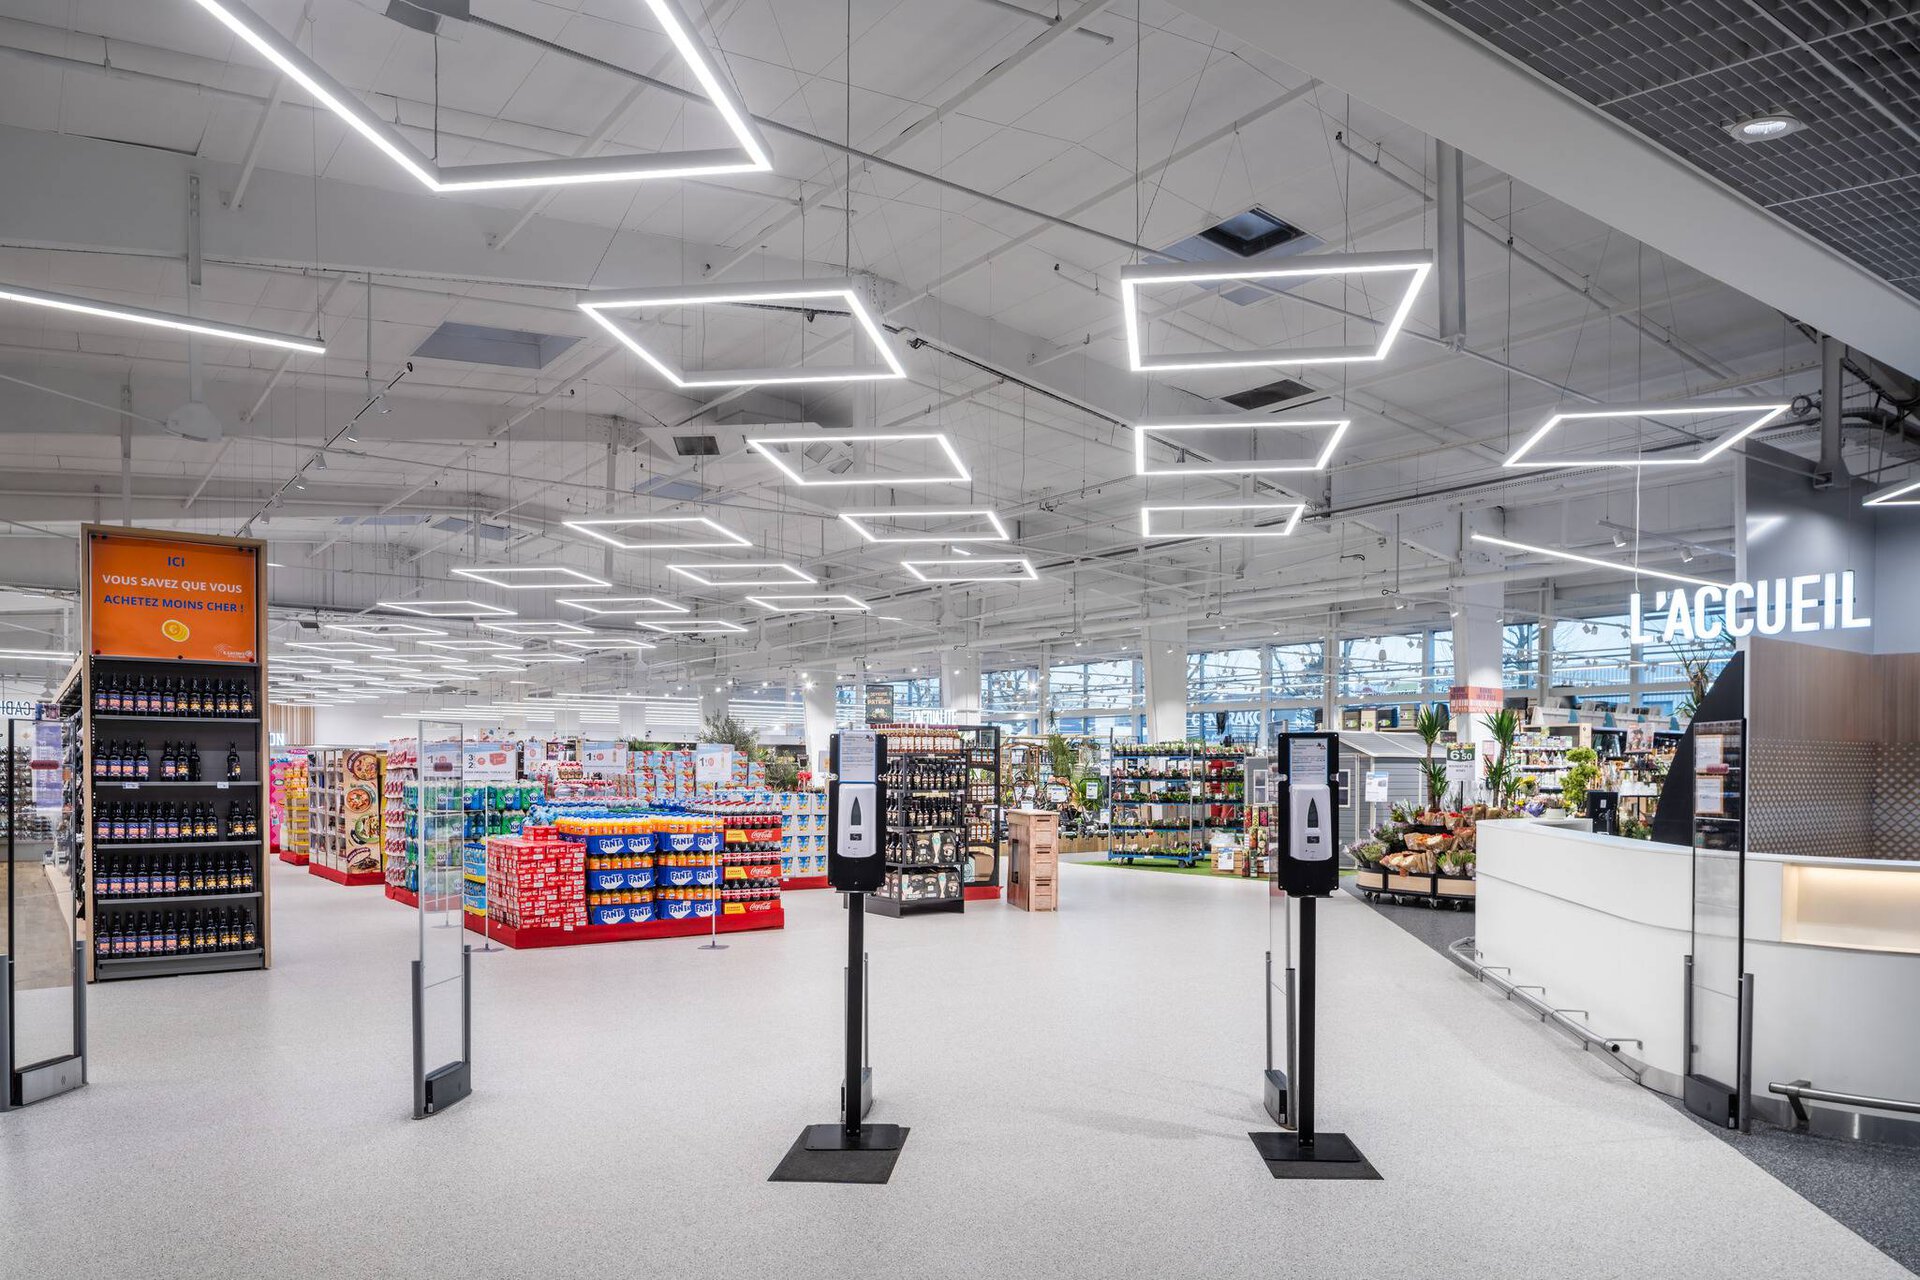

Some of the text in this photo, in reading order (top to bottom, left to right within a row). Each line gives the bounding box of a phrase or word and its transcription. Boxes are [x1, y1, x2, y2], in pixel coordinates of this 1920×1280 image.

[167, 556, 185, 567] ICI
[102, 574, 243, 594] VOUS SAVEZ QUE VOUS
[103, 594, 159, 607] ACHETEZ
[162, 598, 203, 611] MOINS
[206, 601, 237, 612] CHER
[1630, 569, 1872, 644] L'ACCUEIL
[1191, 709, 1276, 726] CENRAKO
[600, 839, 623, 849] FANTA
[628, 838, 650, 848] FANTA
[600, 874, 623, 885] FANTA
[628, 873, 650, 884] FANTA
[629, 907, 651, 917] FANTA
[695, 903, 715, 913] FANT
[601, 909, 624, 919] FANTA
